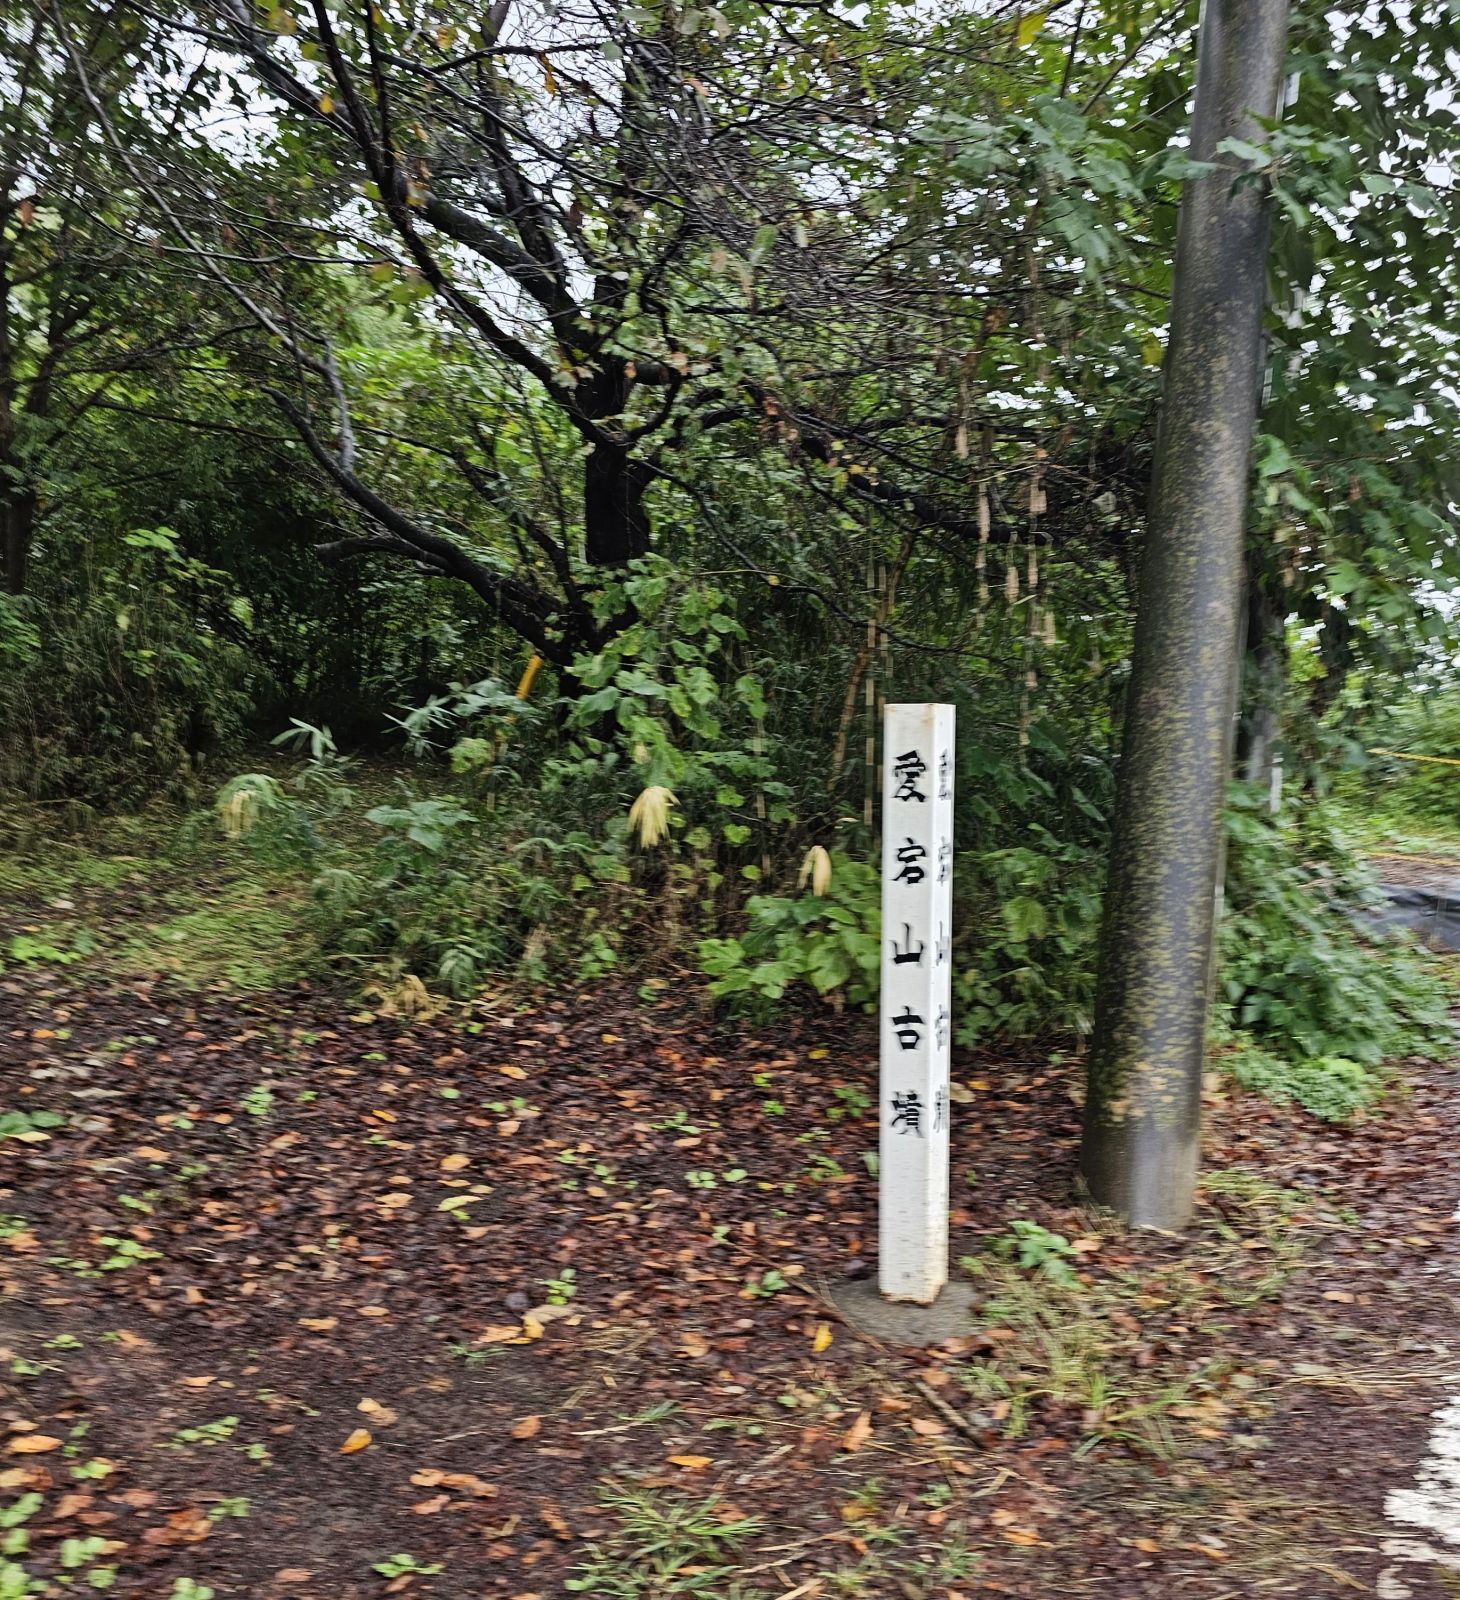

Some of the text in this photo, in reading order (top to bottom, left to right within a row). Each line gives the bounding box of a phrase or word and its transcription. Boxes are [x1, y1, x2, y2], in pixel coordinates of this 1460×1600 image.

[890, 749, 927, 1139] 愛宕山古墳
